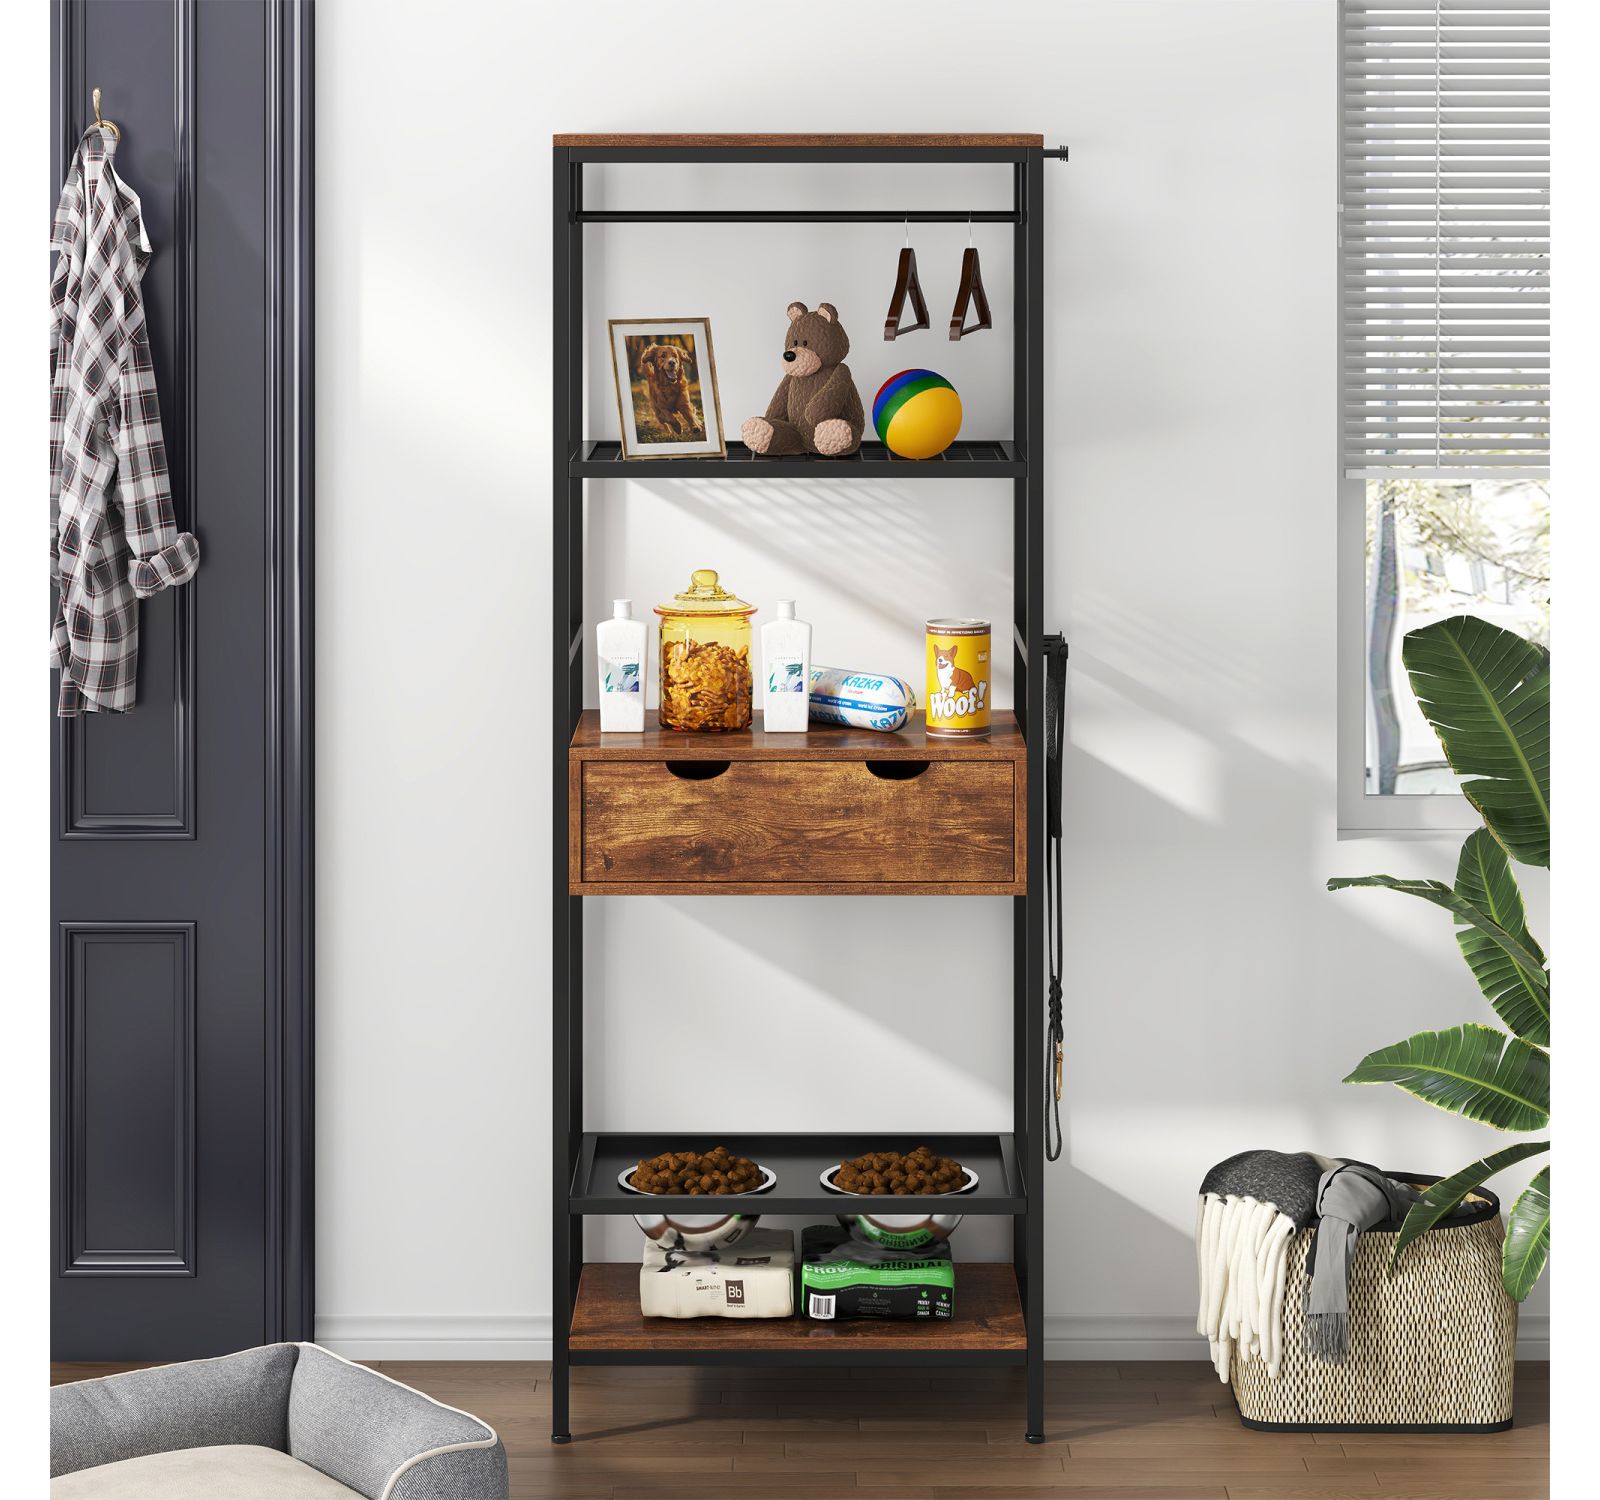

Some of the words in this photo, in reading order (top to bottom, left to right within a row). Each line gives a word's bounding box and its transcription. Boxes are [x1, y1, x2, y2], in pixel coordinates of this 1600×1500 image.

[842, 674, 884, 691] KAZKA
[930, 680, 987, 721] Woof!
[728, 1285, 742, 1298] Bb
